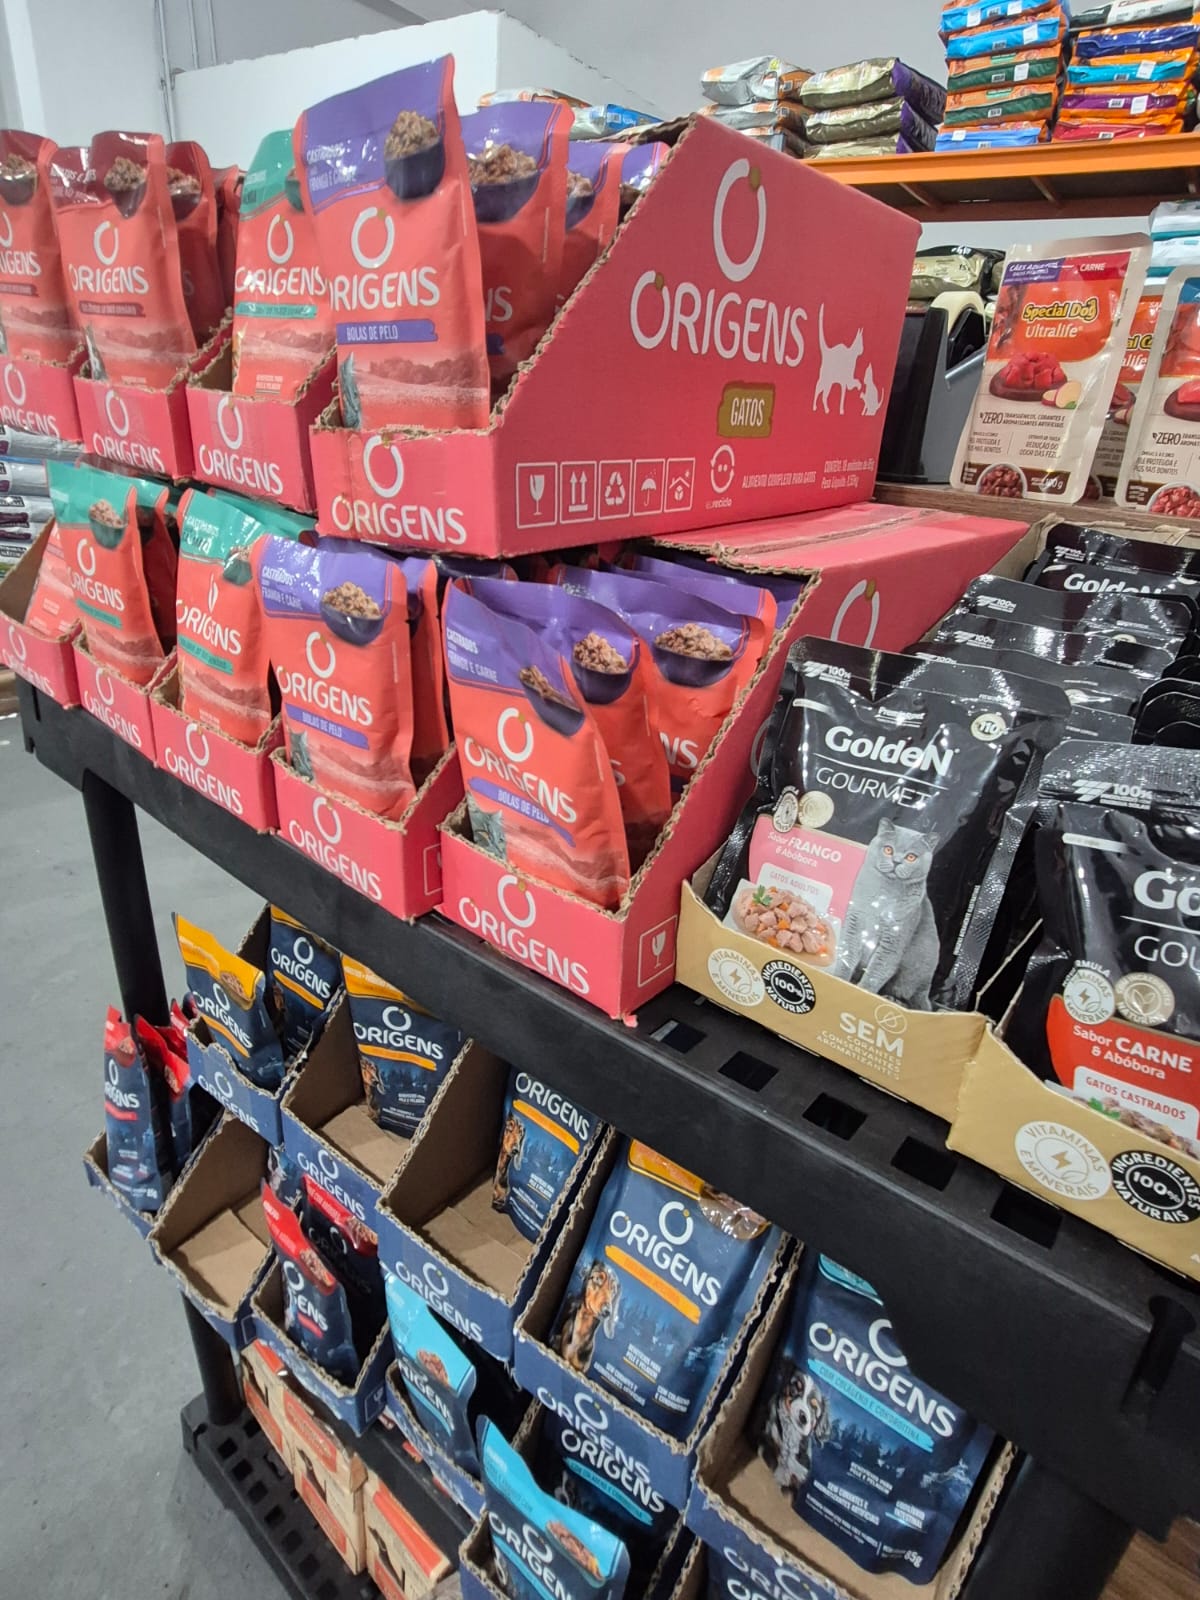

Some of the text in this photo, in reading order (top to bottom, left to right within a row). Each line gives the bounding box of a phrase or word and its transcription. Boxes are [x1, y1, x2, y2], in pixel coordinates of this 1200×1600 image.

[235, 266, 326, 296] ORIGENS
[1079, 262, 1106, 272] CARNE
[368, 325, 378, 340] DE
[378, 323, 399, 340] PELO
[630, 270, 808, 367] ORIGENS
[1023, 298, 1098, 321] Special Dog
[1025, 322, 1079, 339] Ultralife
[729, 397, 765, 427] GATOS
[983, 412, 1004, 425] ZERO
[93, 431, 165, 475] ORIGENS
[1156, 431, 1181, 445] ZERO
[200, 444, 283, 495] ORIGENS
[331, 495, 467, 545] ORIGENS
[262, 565, 294, 586] CASTRADOS
[276, 665, 373, 726] ORIGENS
[83, 690, 142, 748] ORIGENS
[302, 711, 343, 738] BOLAS DE PELO
[824, 725, 952, 777] GoldeN
[165, 747, 243, 815] ORIGENS
[464, 737, 578, 824] ORIGENS
[498, 789, 520, 811] BOLAS
[519, 798, 531, 815] DE
[815, 766, 935, 810] GOURMET
[289, 819, 383, 901] ORIGENS
[787, 836, 842, 863] FRANGO
[458, 897, 591, 995] ORIGENS
[711, 950, 761, 983] VITAMINAS
[270, 946, 331, 1000] ORIGENS
[762, 961, 815, 1002] INGREDIENTES
[774, 977, 803, 998] 100%
[191, 991, 253, 1049] ORIGENS
[765, 985, 811, 1014] NATURAIS
[353, 1021, 444, 1060] ORIGENS
[822, 1030, 900, 1073] CONSERVANTES
[840, 1012, 904, 1057] SEM
[847, 1035, 902, 1066] CORANTES
[1072, 1023, 1194, 1073] Sabor CARNE
[816, 1035, 900, 1080] AROMATIZANTES
[1091, 1045, 1166, 1080] & Abóbora
[515, 1072, 590, 1141] ORIGENS
[1085, 1076, 1187, 1121] GATOS CASTRADOS
[1024, 1124, 1106, 1174] VITAMINAS
[1027, 1158, 1099, 1198] MINERAIS
[1112, 1150, 1200, 1211] INGREDIENTES
[1132, 1170, 1182, 1203] 100%
[1113, 1179, 1190, 1224] NATURAIS
[609, 1209, 723, 1306] ORIGENS
[394, 1260, 484, 1343] ORIGENS
[808, 1321, 957, 1438] ORIGENS
[536, 1386, 651, 1486] ORIGENS
[560, 1428, 665, 1514] ORIGENS
